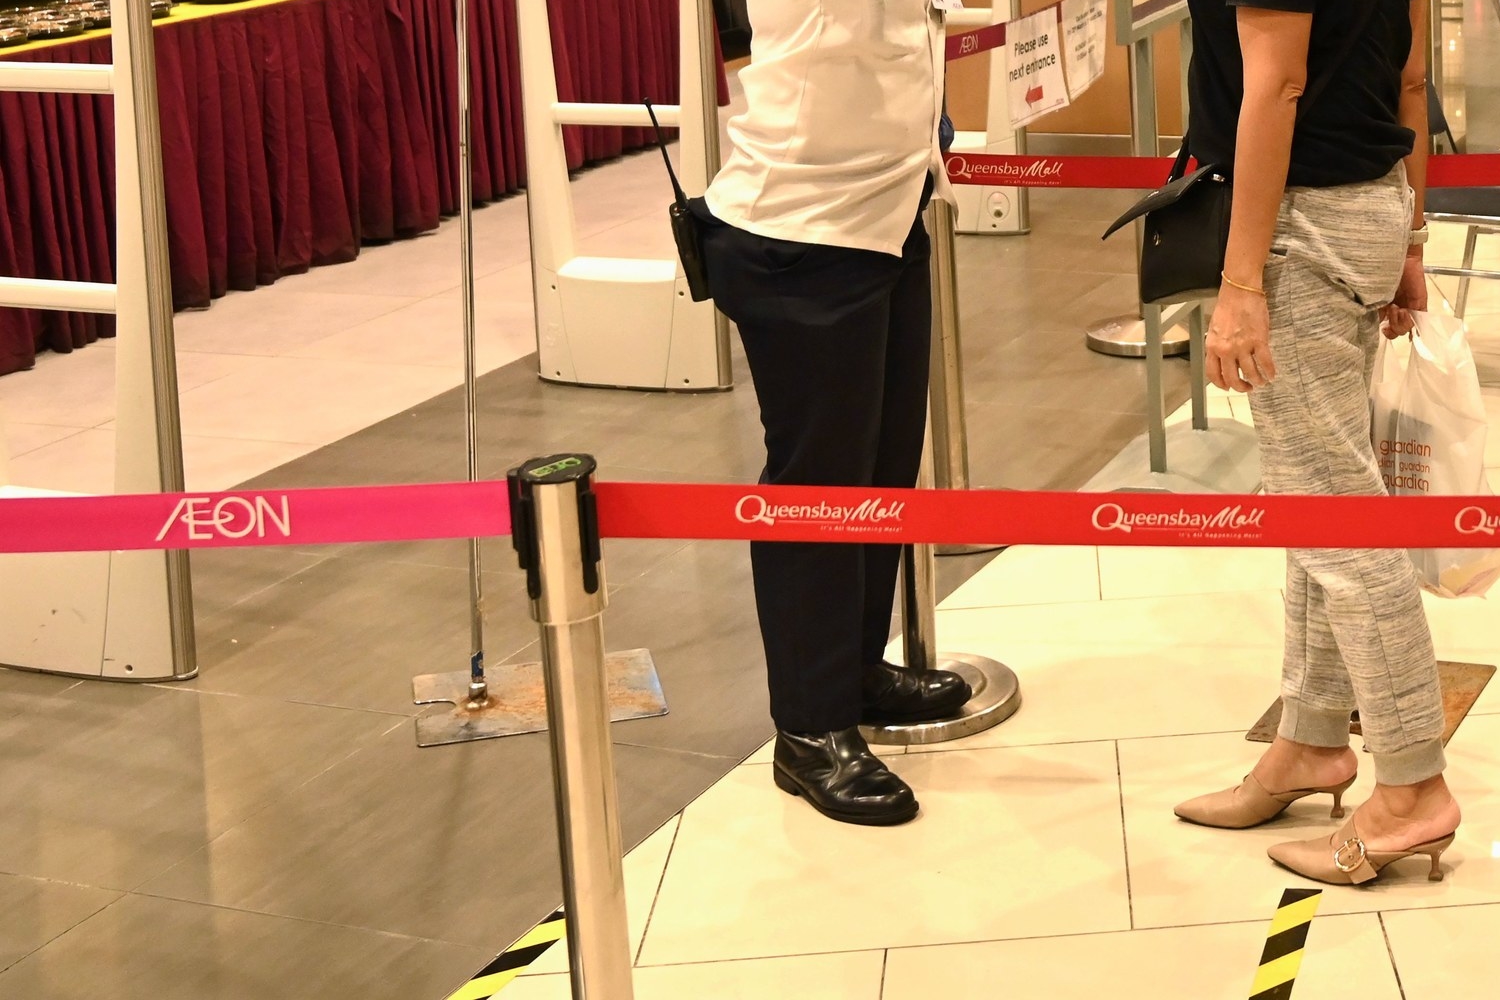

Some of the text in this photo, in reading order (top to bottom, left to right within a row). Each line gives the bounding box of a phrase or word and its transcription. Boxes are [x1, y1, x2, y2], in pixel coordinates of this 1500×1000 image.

[1014, 33, 1049, 58] Please use
[1009, 52, 1056, 83] next entrance
[1379, 438, 1432, 458] guardian
